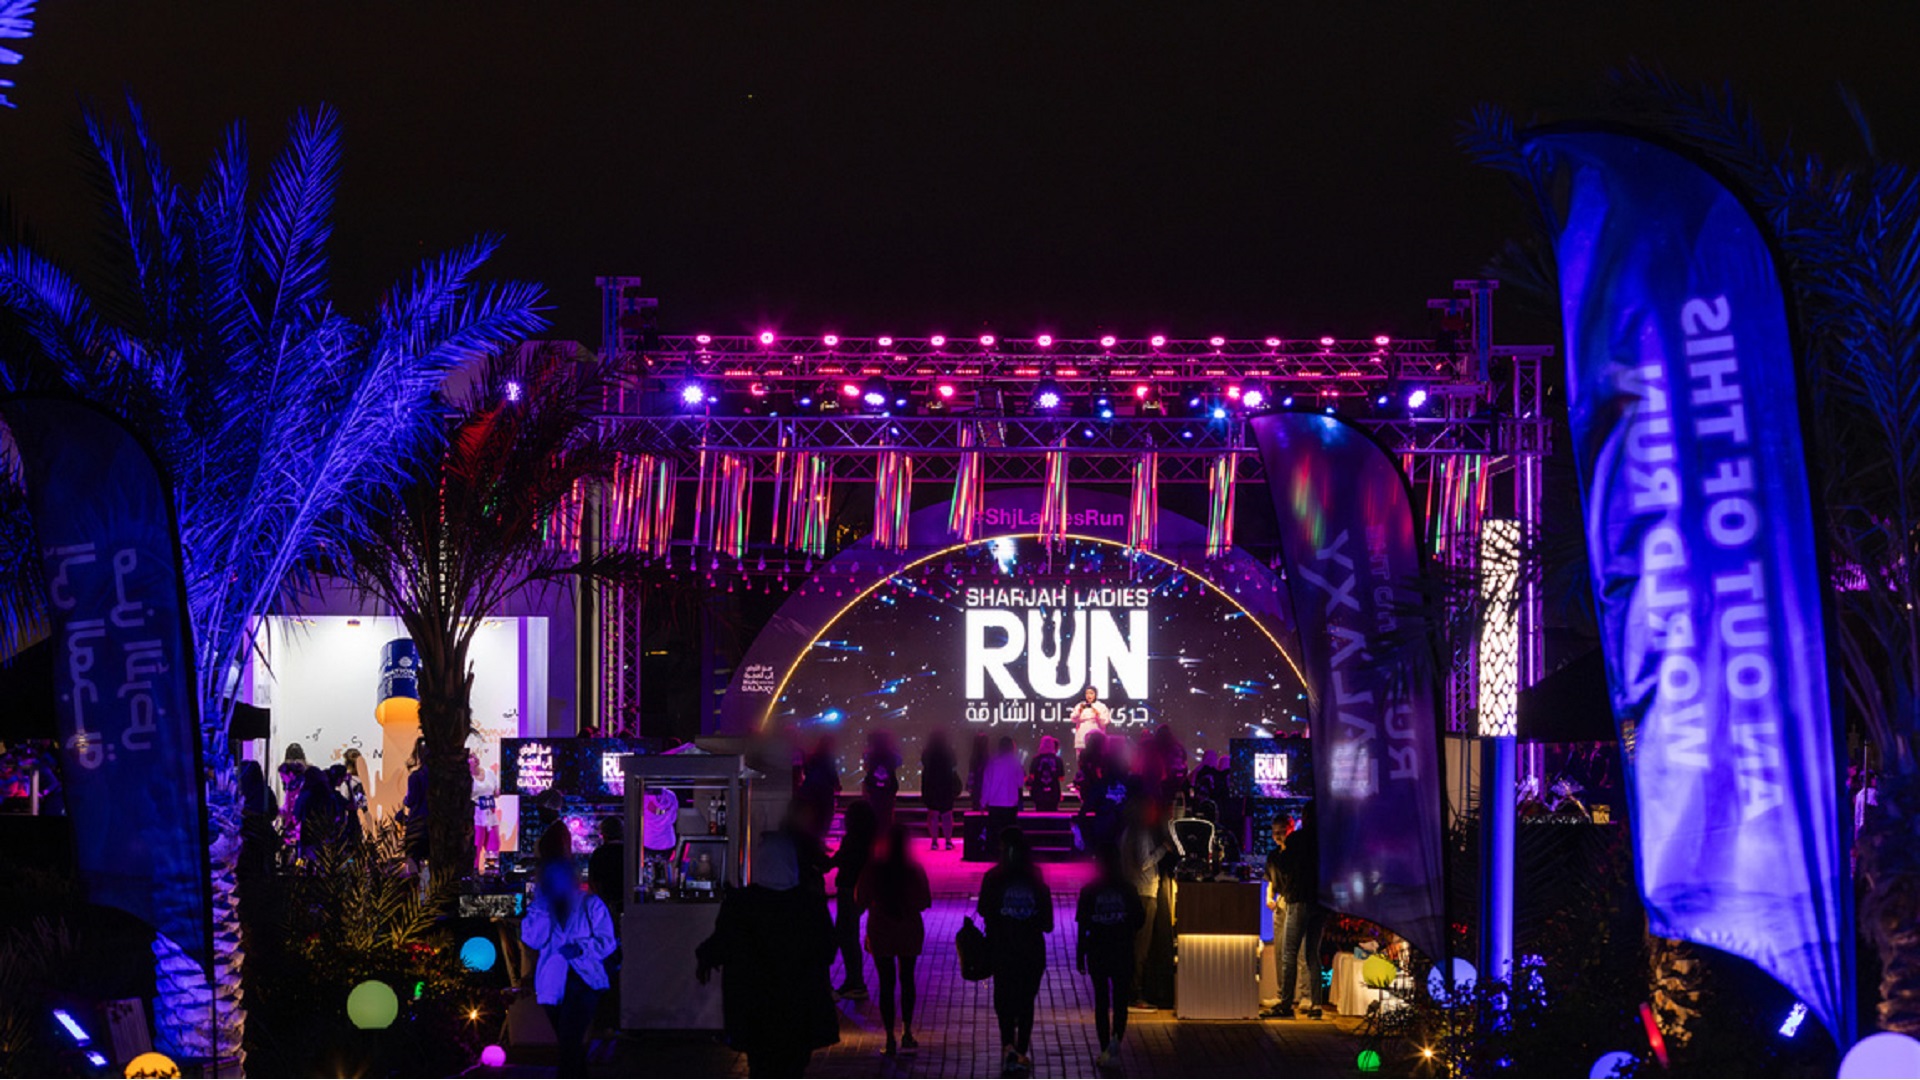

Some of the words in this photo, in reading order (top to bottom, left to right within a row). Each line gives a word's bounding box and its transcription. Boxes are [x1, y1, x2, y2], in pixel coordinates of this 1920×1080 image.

[973, 508, 1124, 529] #ShjLaiesRun
[966, 588, 1066, 606] SHARJAH
[1075, 588, 1148, 606] LADIES
[966, 609, 1148, 699] RUN
[966, 700, 1035, 727] الشارقة
[1255, 758, 1287, 779] RUN
[517, 777, 553, 789] GALAXY
